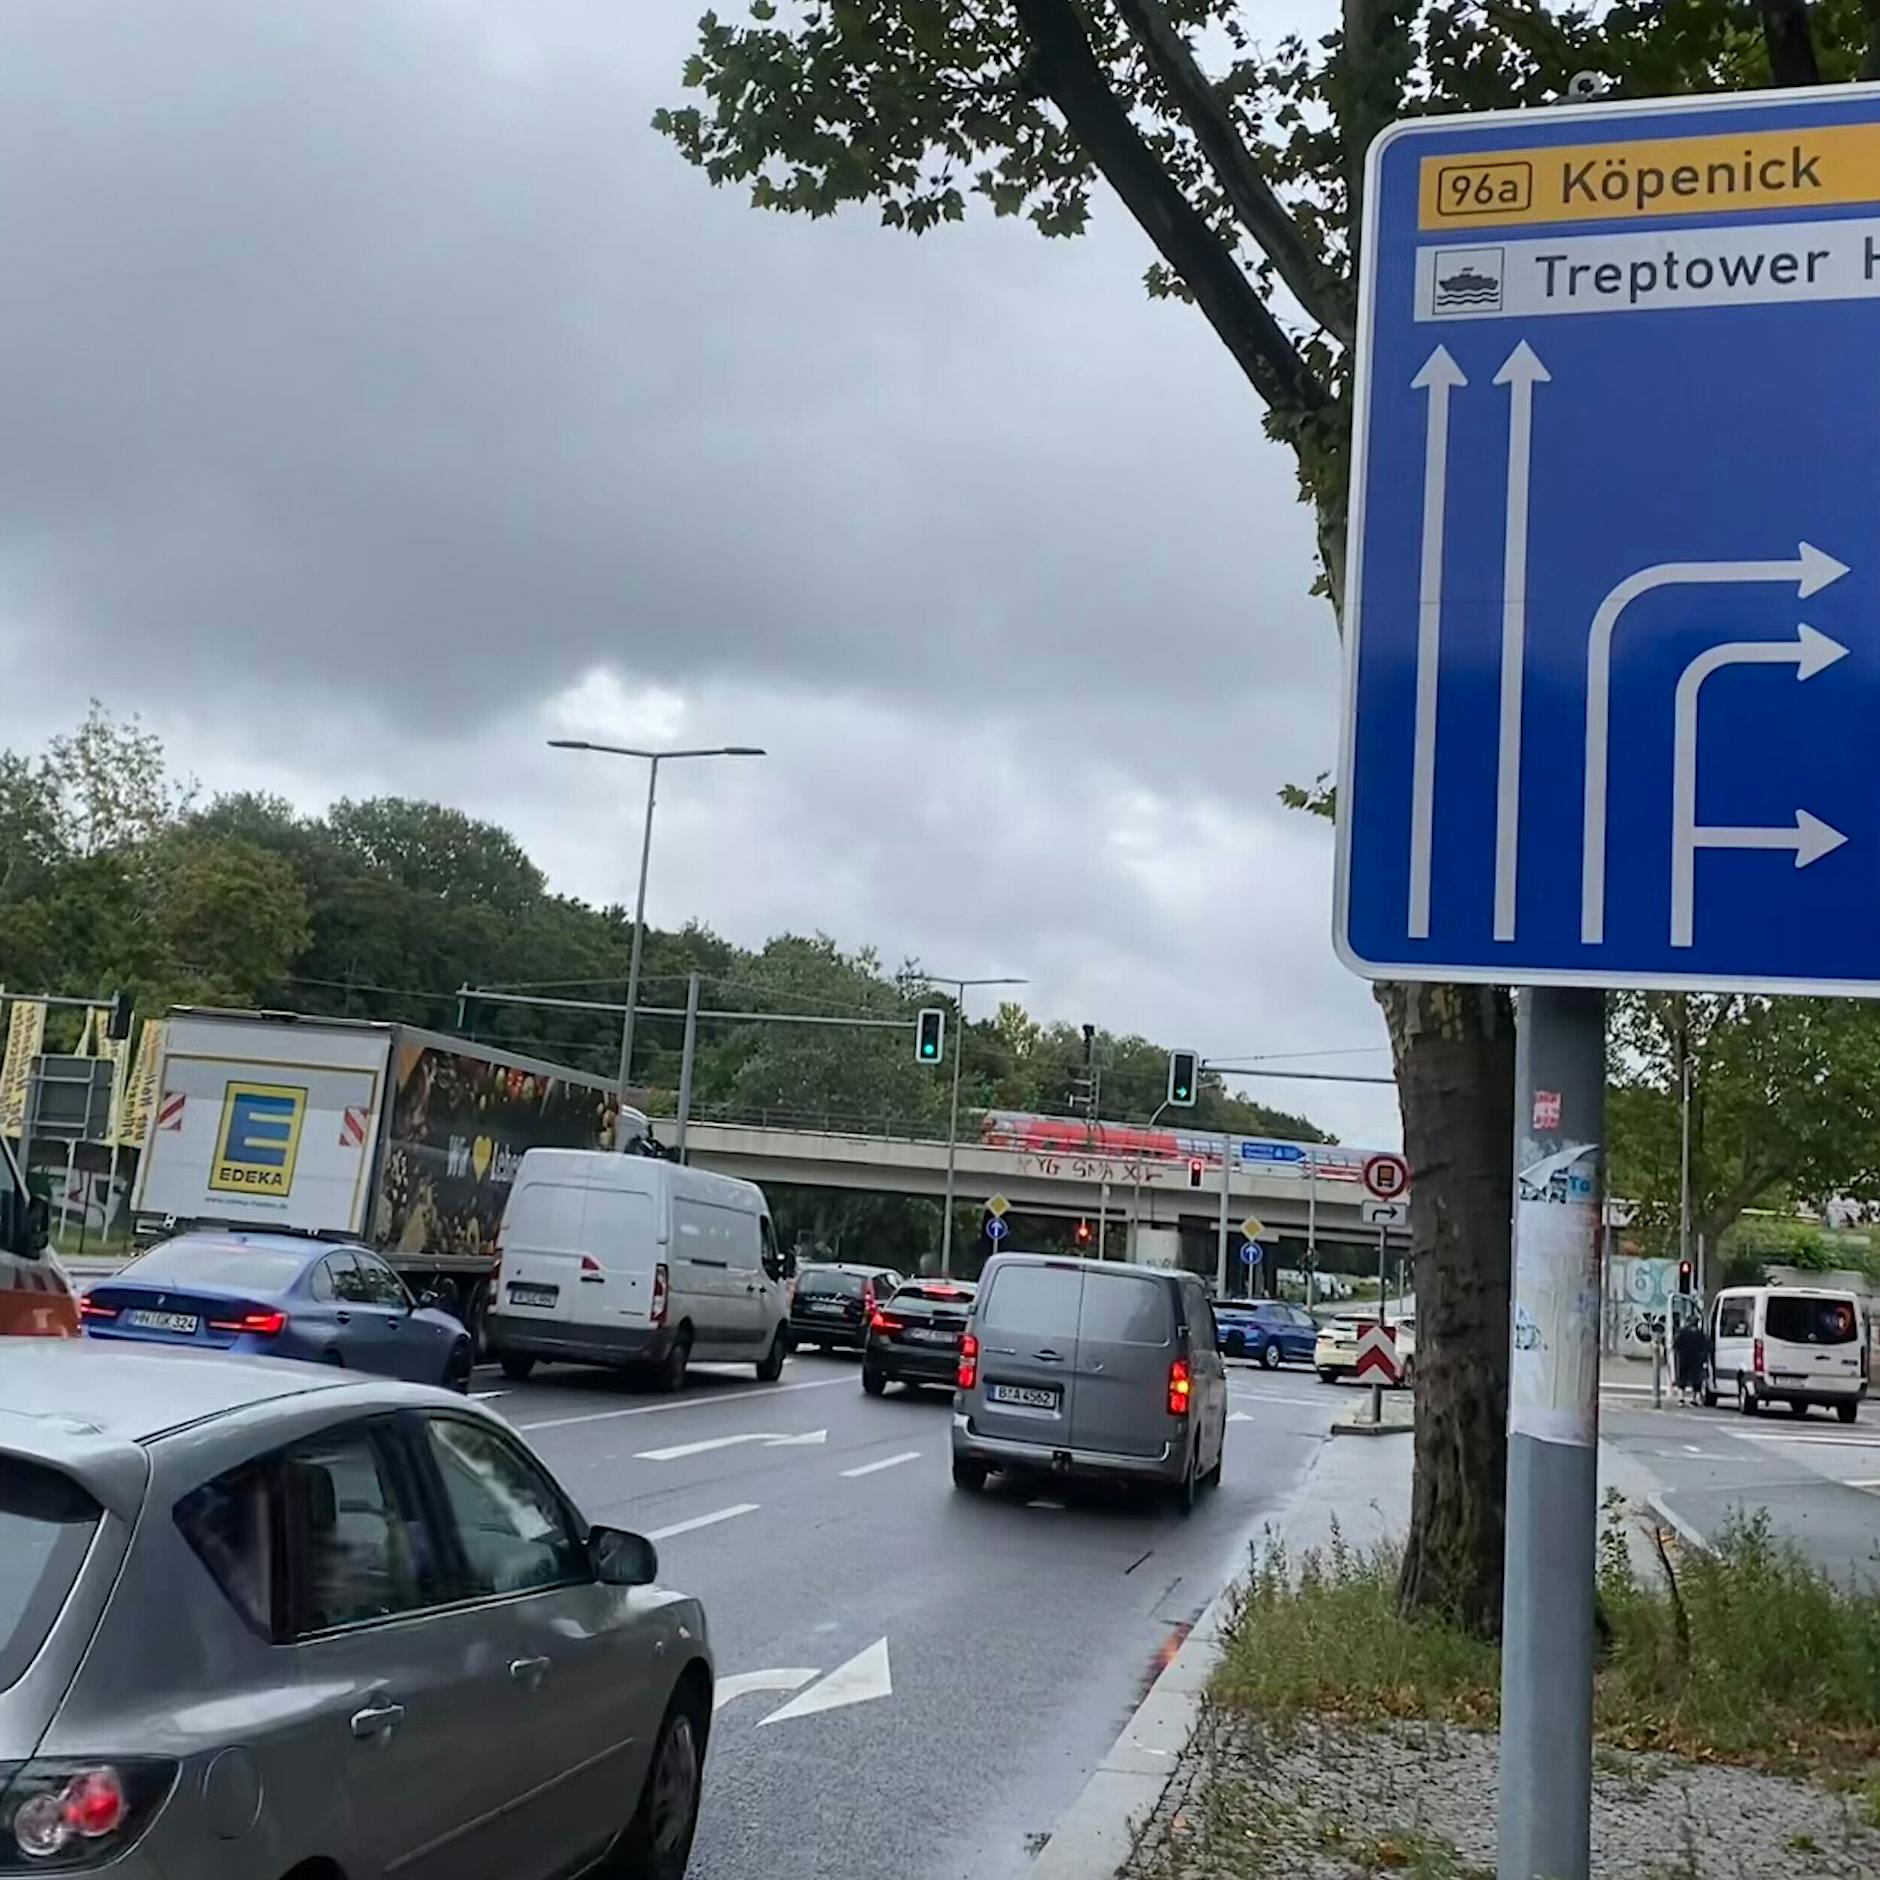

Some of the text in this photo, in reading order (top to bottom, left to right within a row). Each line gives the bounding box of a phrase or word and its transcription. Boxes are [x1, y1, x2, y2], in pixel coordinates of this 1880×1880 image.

[1451, 145, 1822, 210] 96a Köpenick
[1534, 248, 1831, 304] Treptower
[446, 1134, 472, 1178] Wir
[219, 1167, 284, 1186] EDEKA
[173, 1314, 194, 1329] 324
[998, 1386, 1007, 1399] B
